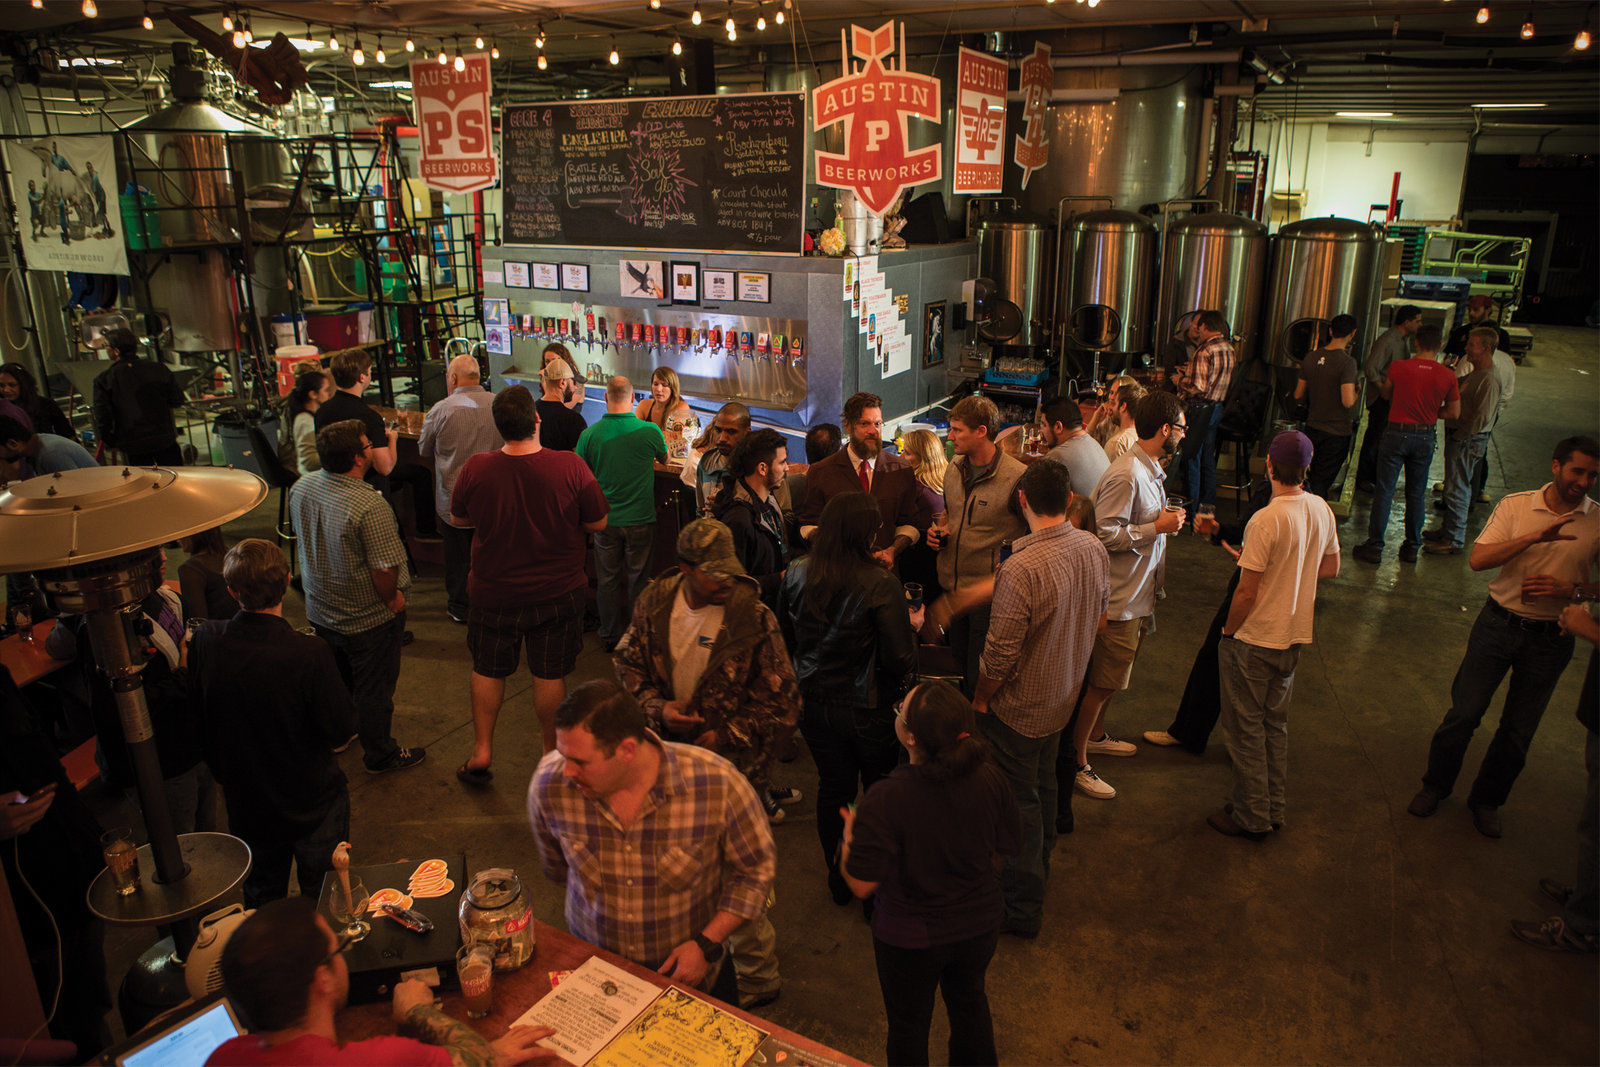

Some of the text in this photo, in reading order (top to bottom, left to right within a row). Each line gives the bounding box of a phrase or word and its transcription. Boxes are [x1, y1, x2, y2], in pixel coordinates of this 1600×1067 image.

[419, 66, 483, 87] AUSTIN
[963, 60, 1005, 91] AUSTIN
[822, 81, 929, 116] AUSTIN
[542, 109, 553, 126] 4
[610, 130, 628, 143] IPA
[865, 119, 890, 153] P
[424, 162, 492, 175] BEERWORKS
[568, 162, 598, 176] BATTLE
[824, 159, 932, 181] BEERWORKS
[958, 170, 1000, 185] BEERWORKS
[750, 182, 788, 198] Chocula
